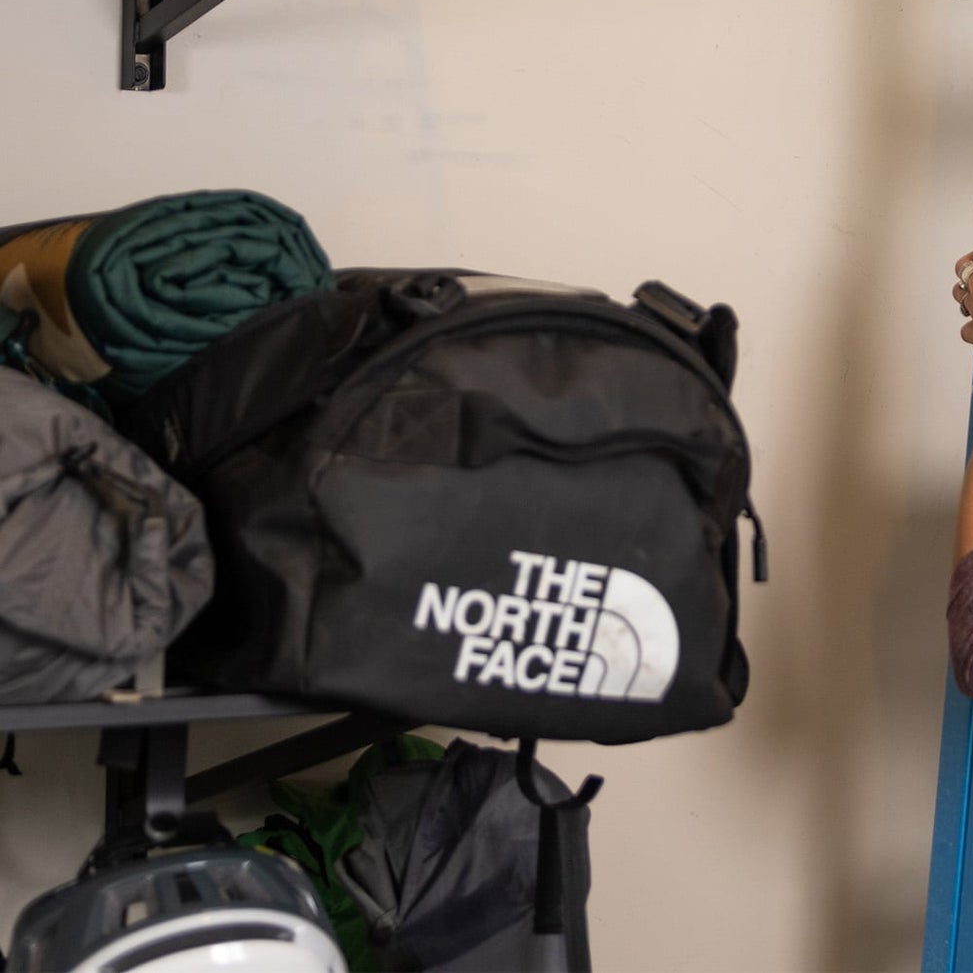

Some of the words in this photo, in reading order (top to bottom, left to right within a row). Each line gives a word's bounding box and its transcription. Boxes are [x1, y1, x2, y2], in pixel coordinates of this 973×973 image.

[509, 549, 609, 609] THE
[413, 582, 598, 652] NORTH
[454, 635, 588, 695] FACE
